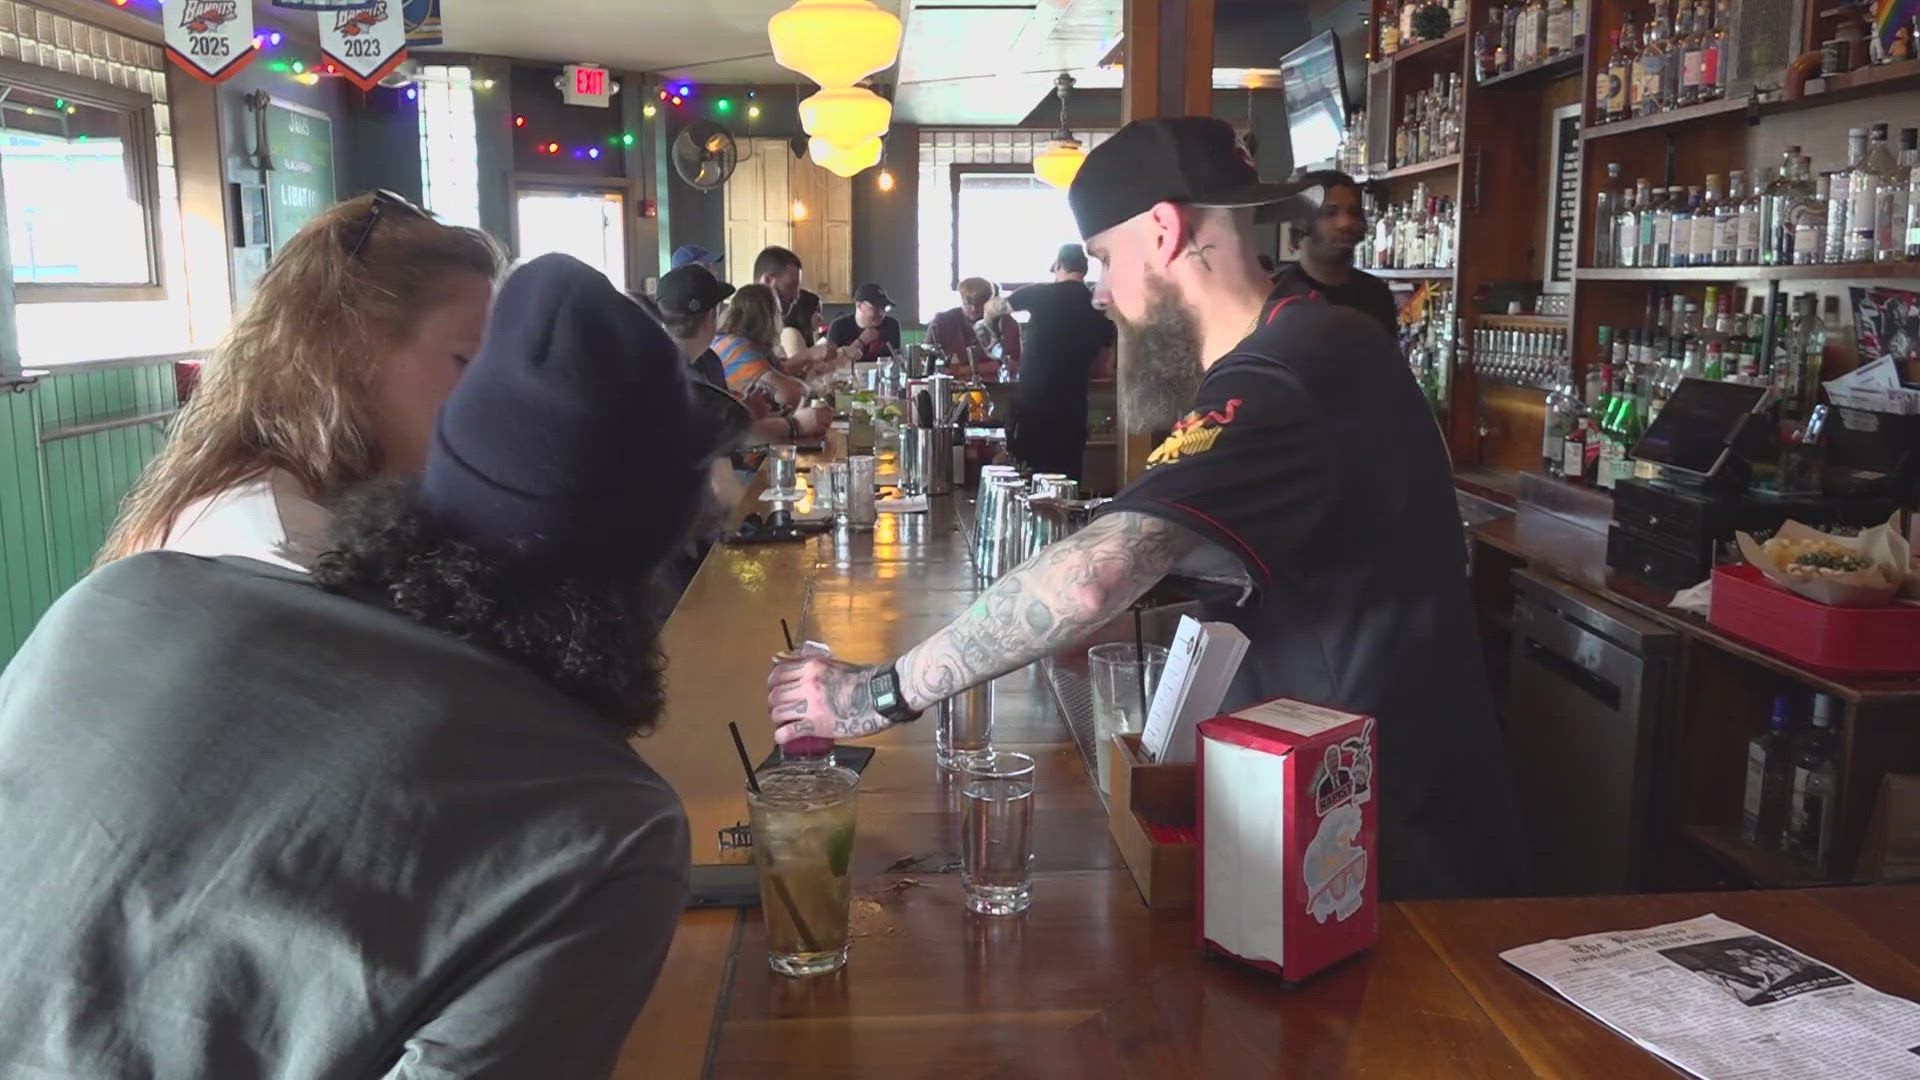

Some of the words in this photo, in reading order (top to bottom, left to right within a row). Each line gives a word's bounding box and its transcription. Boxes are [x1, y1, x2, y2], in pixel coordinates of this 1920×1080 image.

[189, 36, 230, 56] 2025
[344, 38, 381, 57] 2023
[576, 68, 605, 96] EXIT
